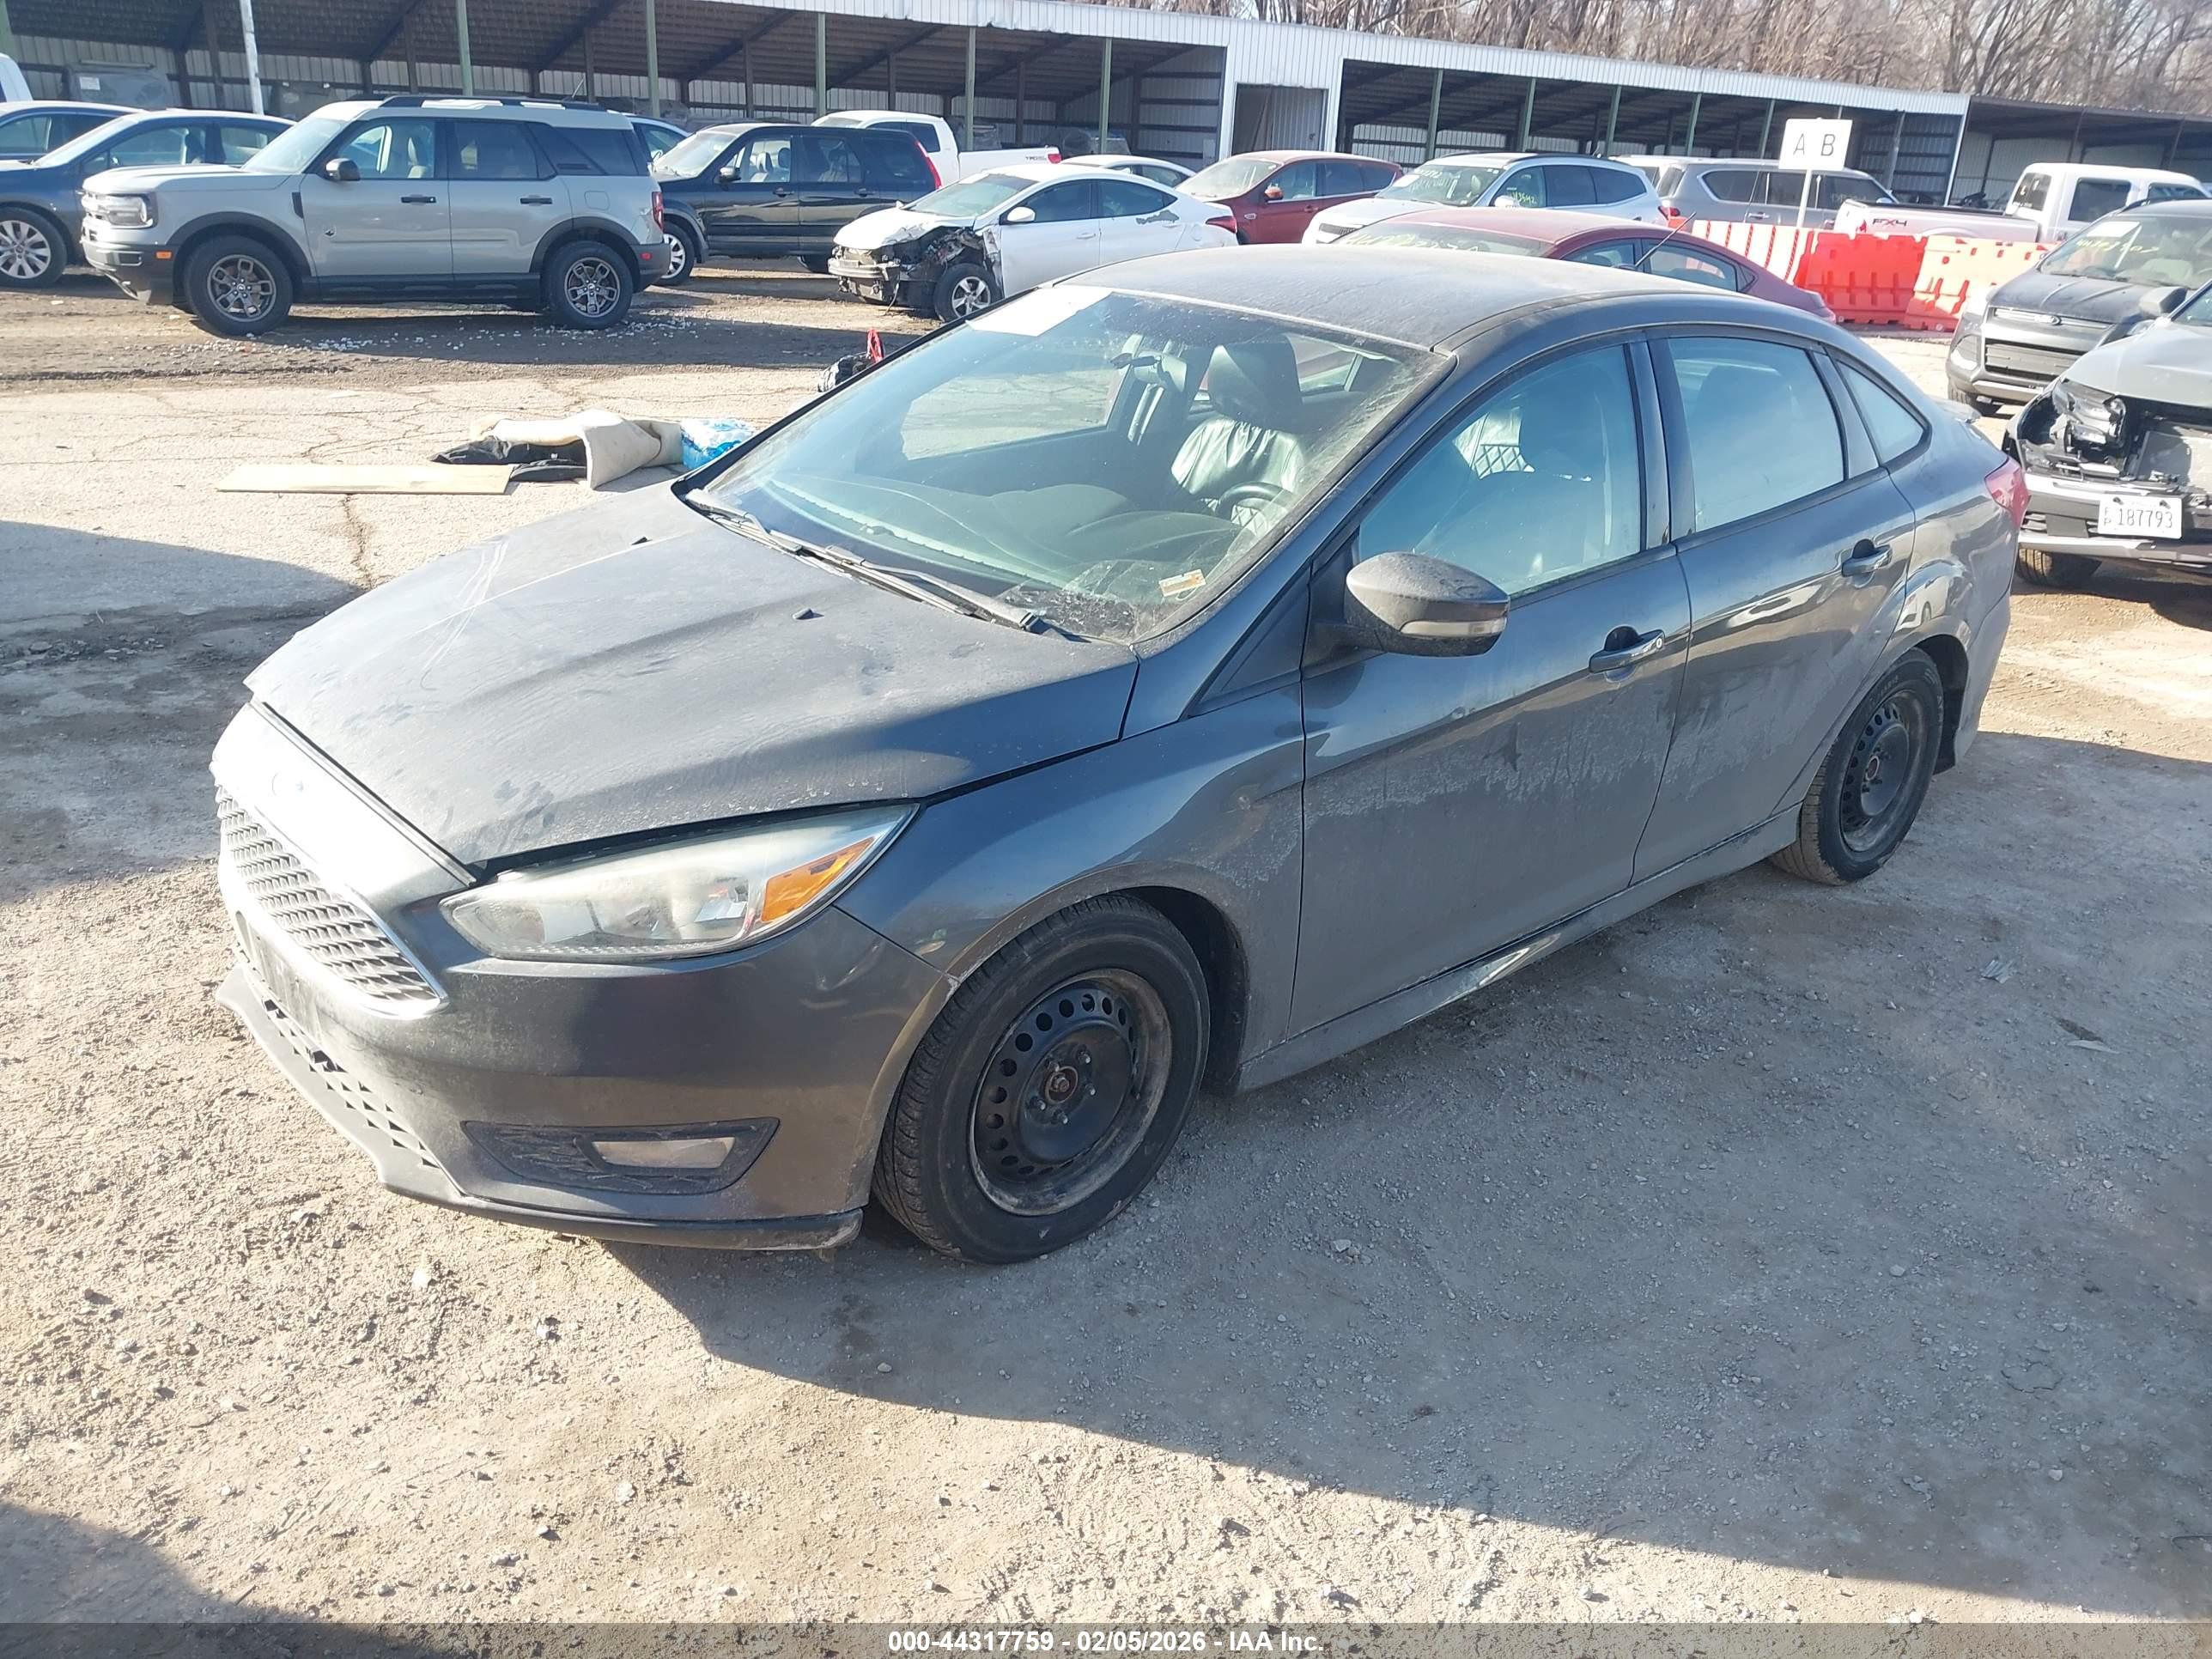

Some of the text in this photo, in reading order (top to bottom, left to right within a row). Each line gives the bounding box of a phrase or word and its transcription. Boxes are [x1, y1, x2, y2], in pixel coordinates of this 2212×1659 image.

[1793, 133, 1836, 156] A B
[1872, 218, 1907, 227] FX4
[2118, 507, 2173, 529] 187793
